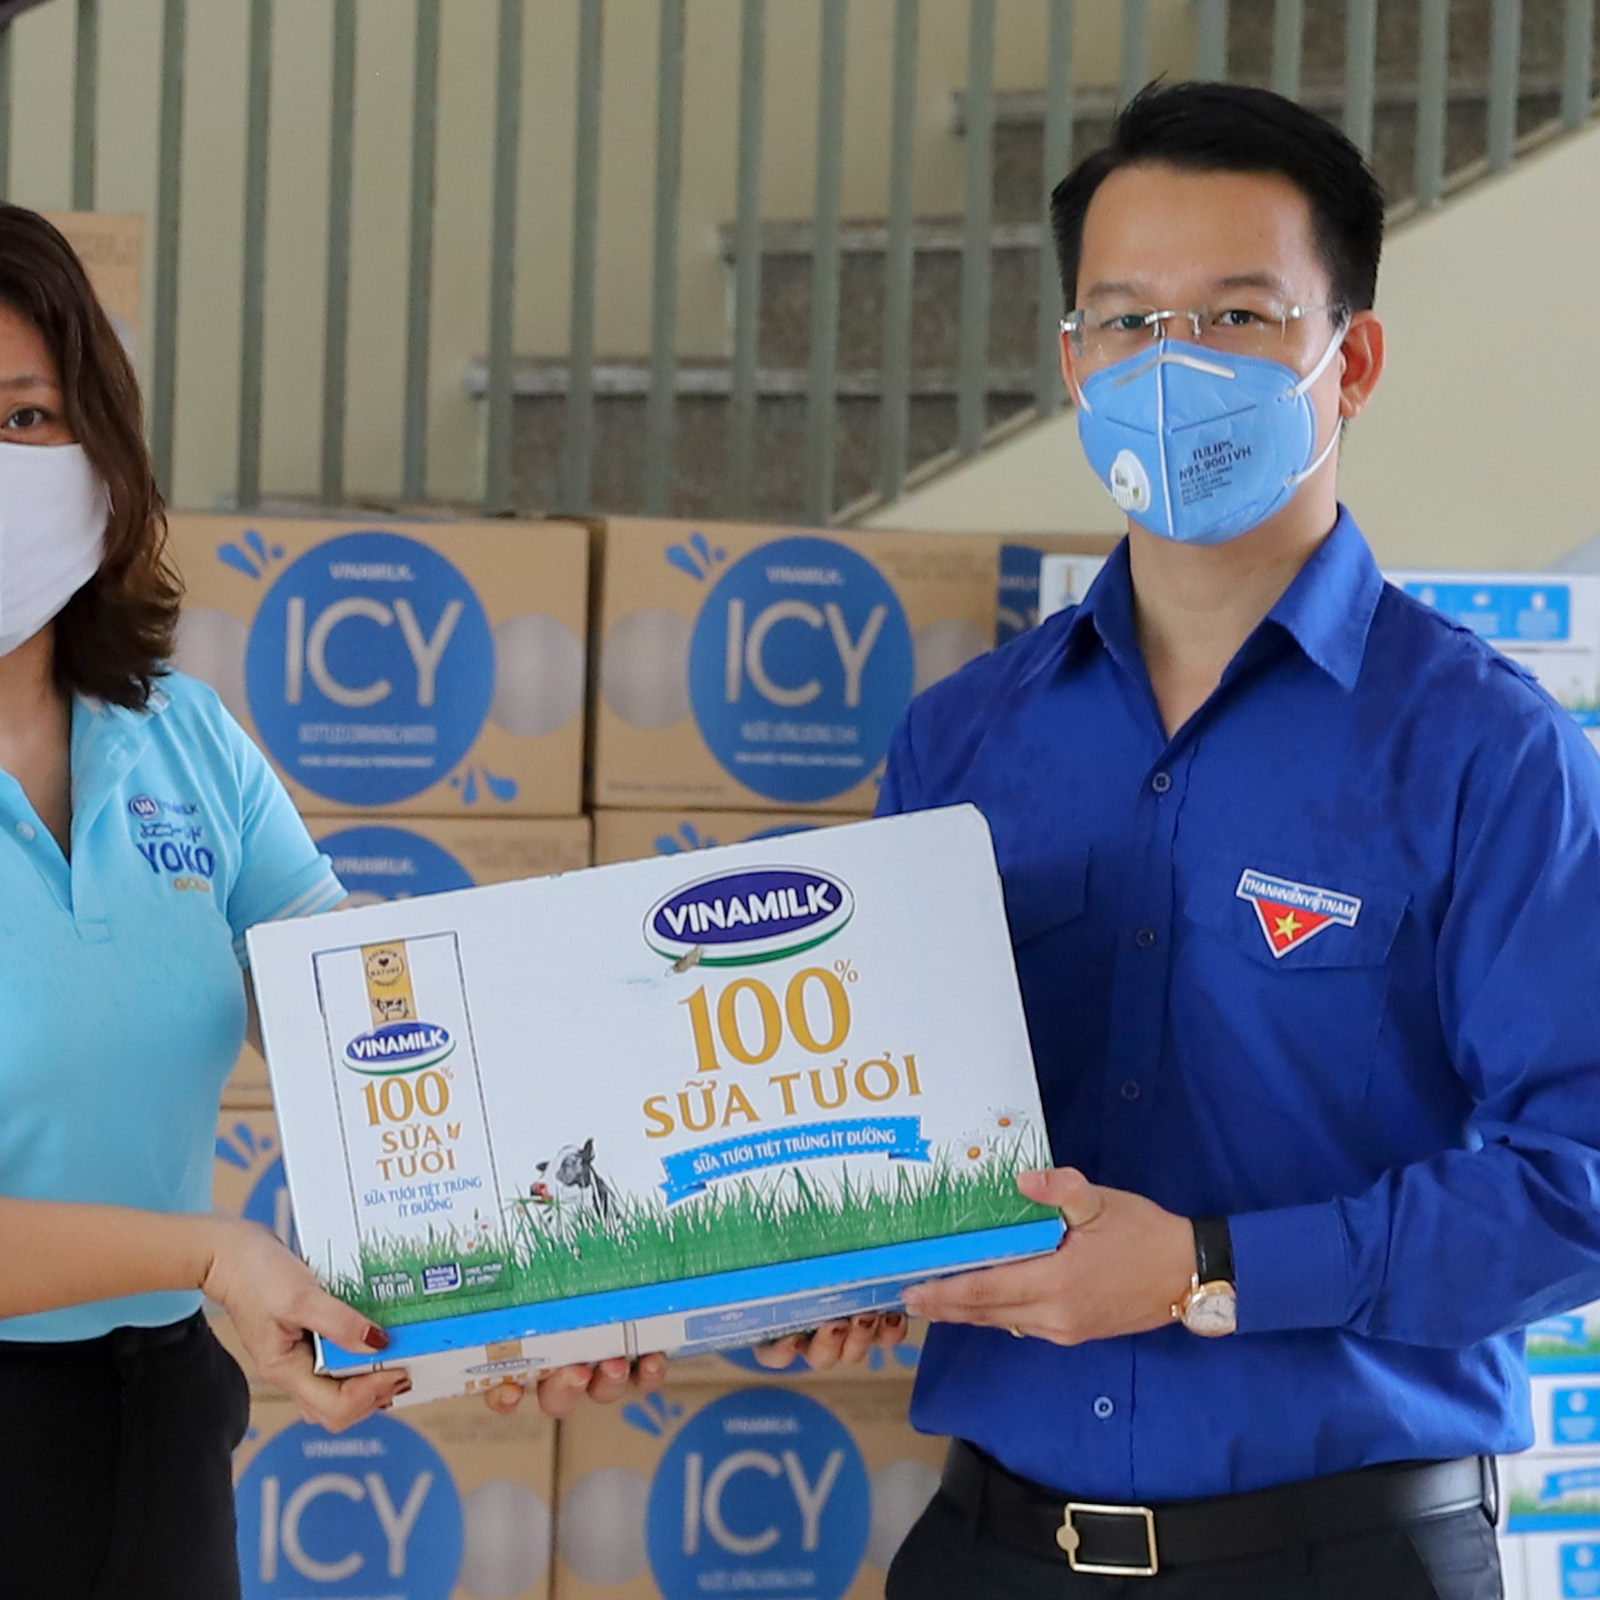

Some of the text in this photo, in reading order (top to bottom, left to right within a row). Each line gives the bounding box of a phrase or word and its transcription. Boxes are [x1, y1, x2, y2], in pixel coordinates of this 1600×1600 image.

[1193, 440, 1233, 460] TULIPS
[330, 563, 413, 581] VINAMILK
[766, 566, 842, 585] VINAMILK
[286, 597, 463, 706] ICY
[726, 598, 887, 706] ICY
[136, 842, 216, 878] YOKO
[334, 857, 417, 875] VINAMILK
[663, 883, 835, 937] VINAMILK
[677, 958, 859, 1074] 100%
[351, 1029, 445, 1059] VINAMILK
[642, 1052, 923, 1139] SỮA TƯƠI
[381, 1123, 443, 1154] SỮA
[693, 1125, 897, 1175] SỮA TƯƠI TIỆT TRÙNG ÍT ĐƯỜNG
[376, 1145, 457, 1181] TƯƠI
[364, 1176, 483, 1207] SỮA TƯƠI TIỆT TRÙNG
[398, 1197, 454, 1218] ÍT ĐƯỜNG
[372, 1282, 395, 1300] 180
[397, 1278, 415, 1295] ml
[303, 1439, 384, 1457] VINAMILK
[684, 1451, 843, 1554] ICY
[260, 1472, 433, 1582] ICY
